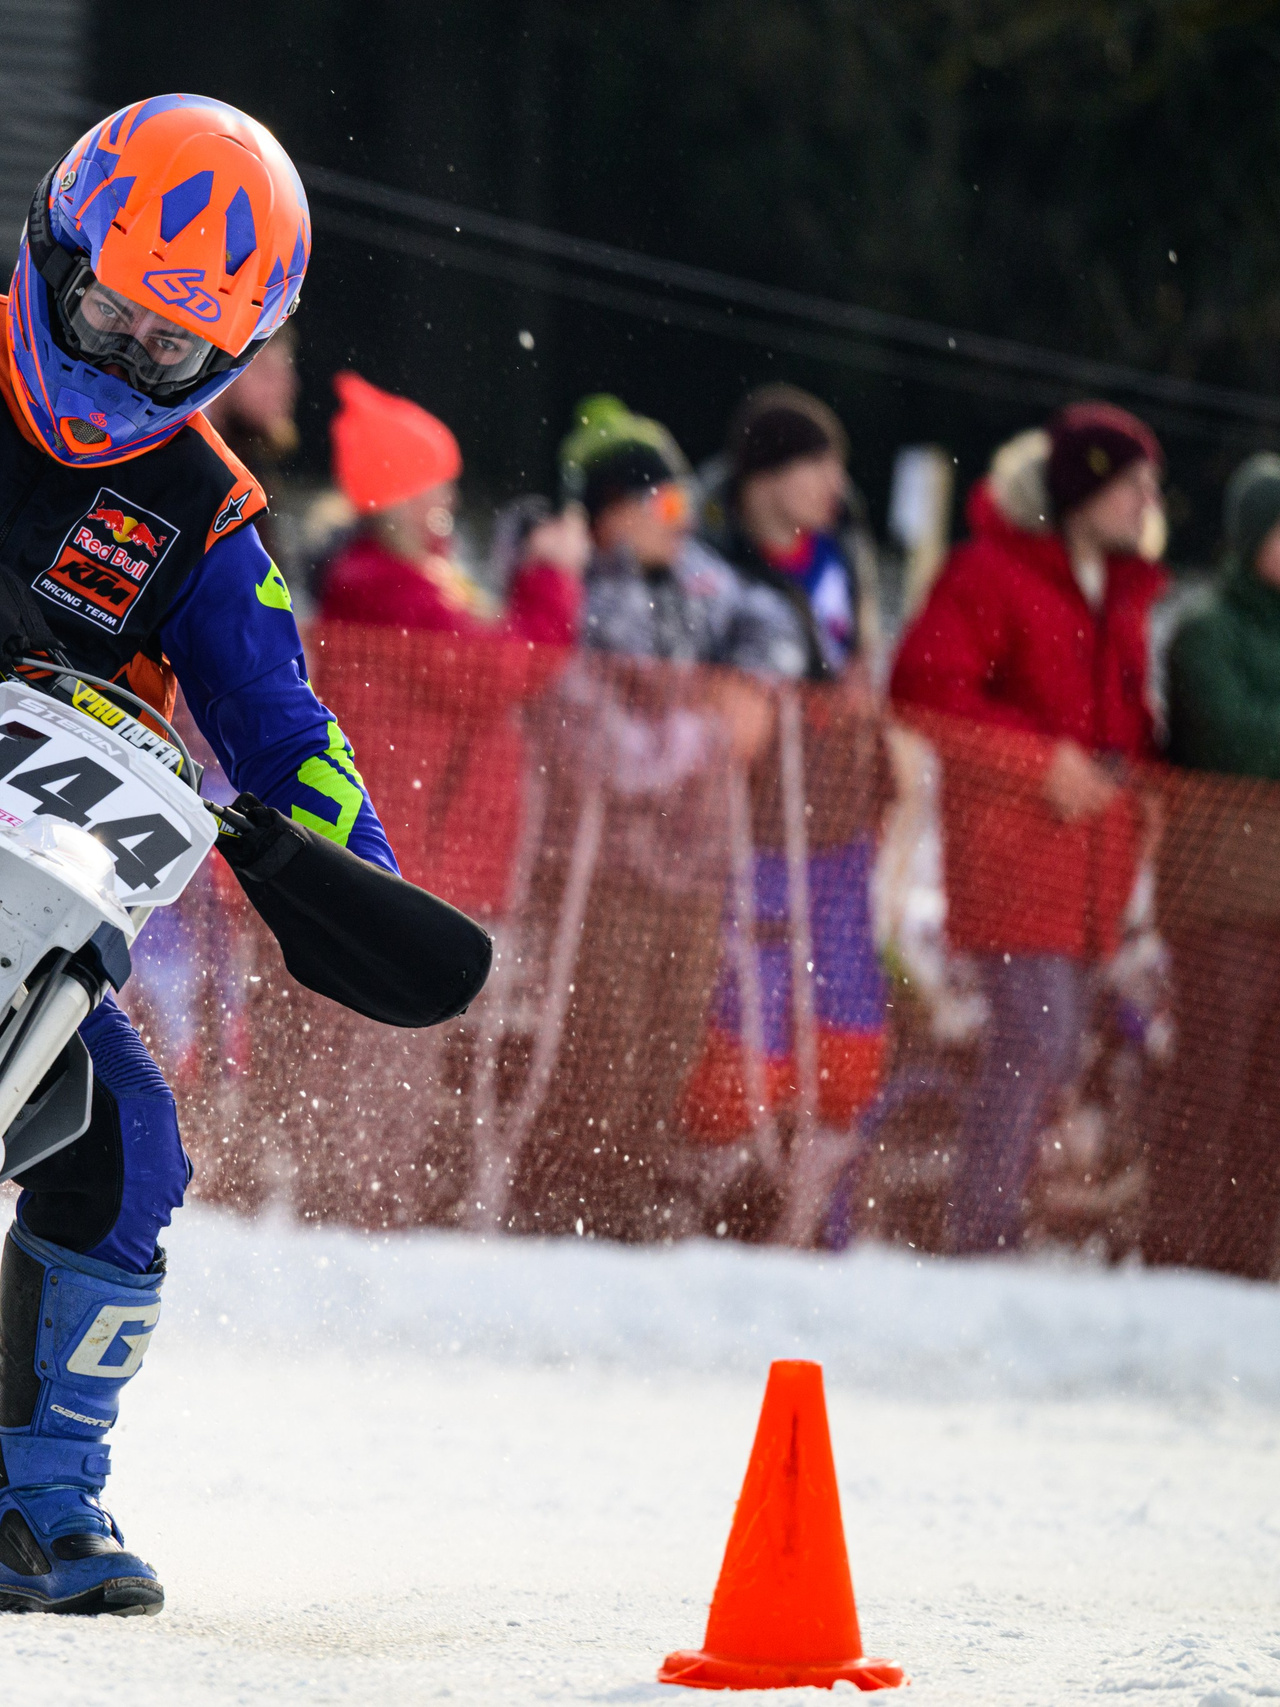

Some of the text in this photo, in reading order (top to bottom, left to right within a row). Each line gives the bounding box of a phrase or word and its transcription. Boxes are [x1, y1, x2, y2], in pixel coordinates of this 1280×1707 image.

[142, 268, 221, 323] 6D
[73, 526, 150, 581] Red Bull
[40, 578, 117, 626] RACING TEAM
[57, 558, 132, 606] KTM
[17, 699, 122, 758] STERIN
[76, 687, 182, 769] PROTAPER
[66, 1301, 161, 1379] G
